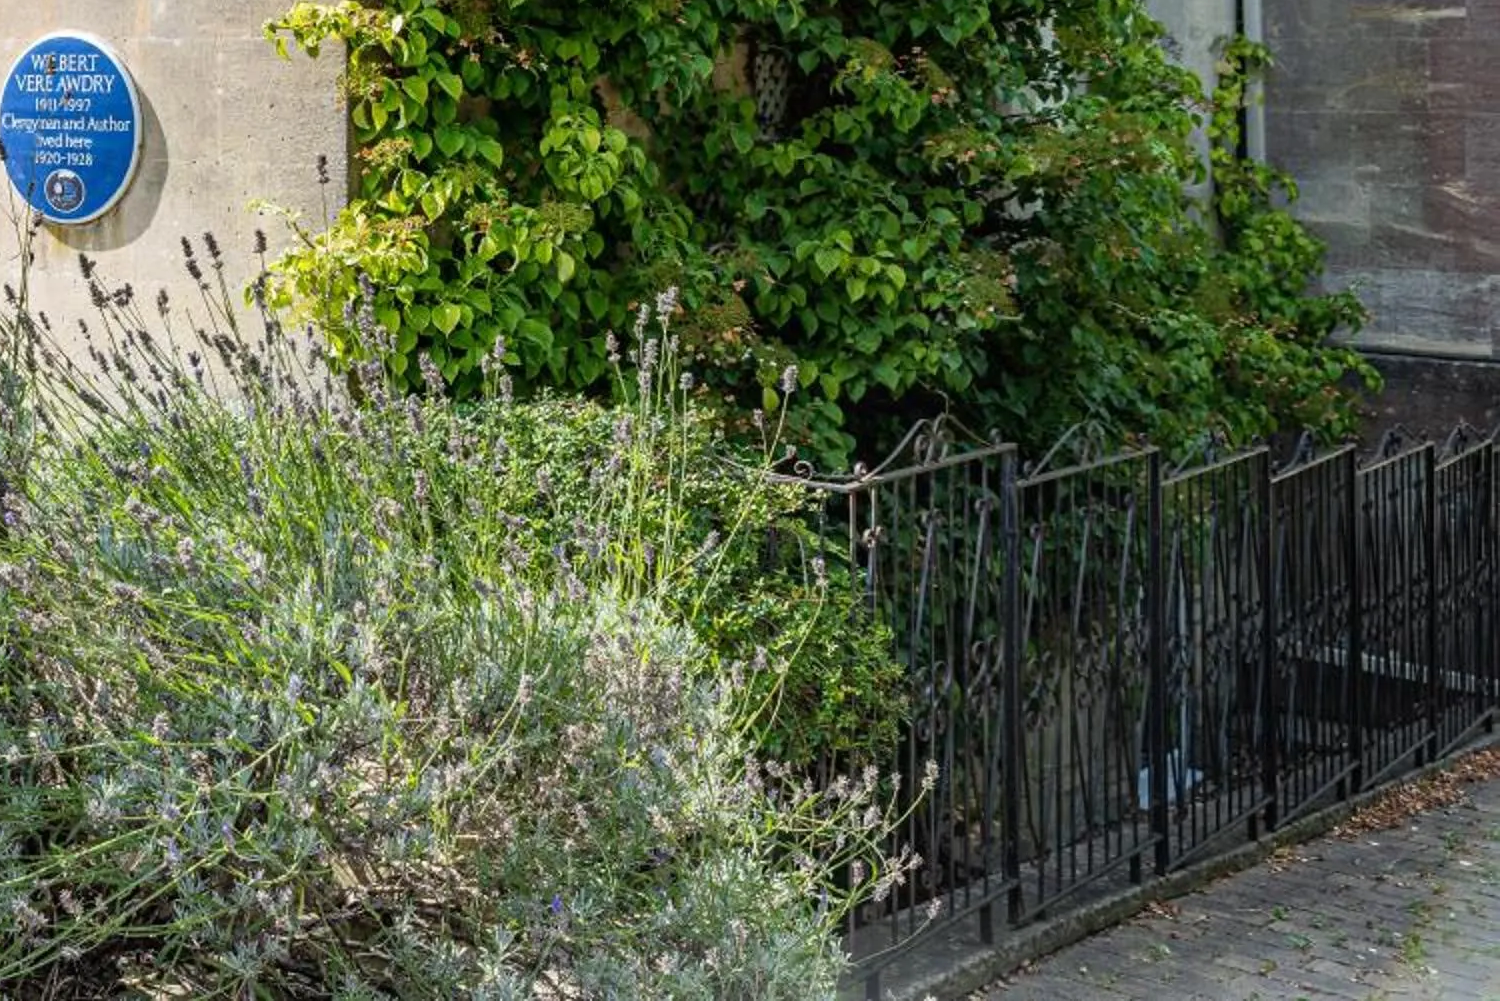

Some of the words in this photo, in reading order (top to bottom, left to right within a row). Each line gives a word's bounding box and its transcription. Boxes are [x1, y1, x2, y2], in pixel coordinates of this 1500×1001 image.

[31, 53, 100, 72] WLBERT
[15, 74, 53, 92] VERE
[55, 75, 115, 93] AWDRY
[62, 117, 85, 130] and
[87, 115, 131, 131] Author
[65, 132, 92, 149] here
